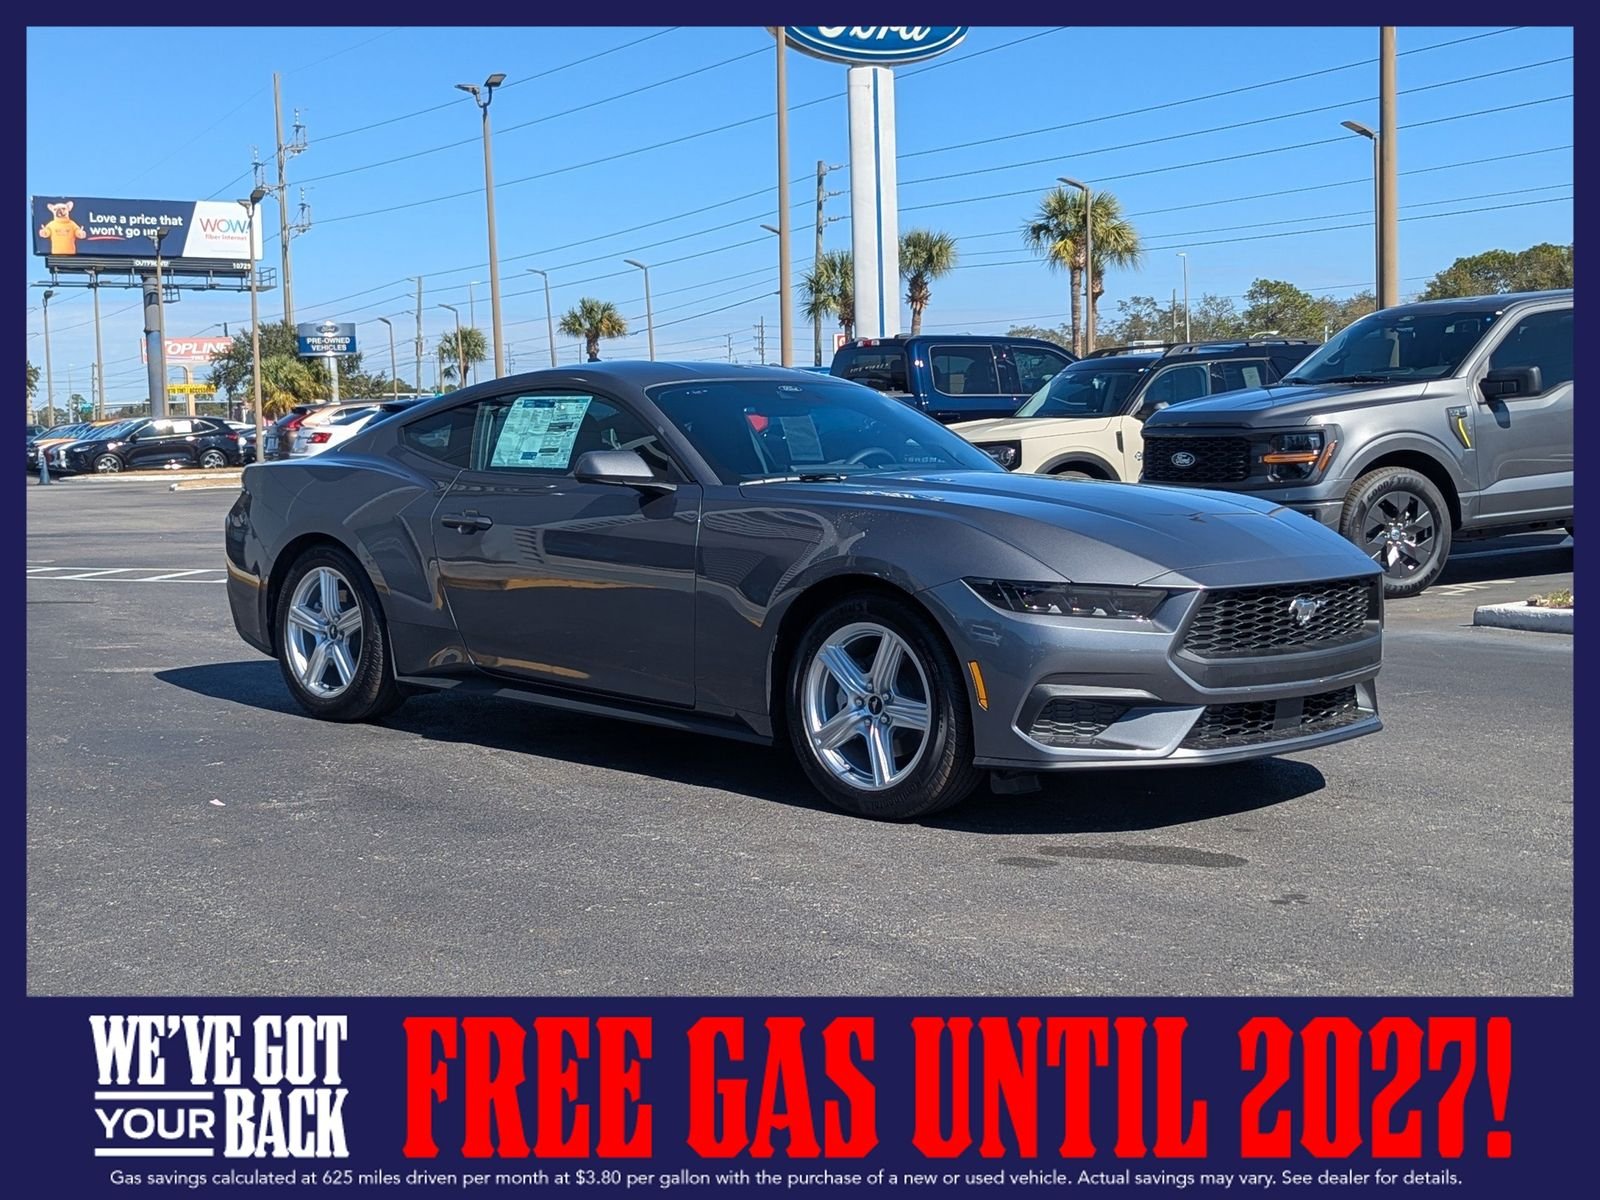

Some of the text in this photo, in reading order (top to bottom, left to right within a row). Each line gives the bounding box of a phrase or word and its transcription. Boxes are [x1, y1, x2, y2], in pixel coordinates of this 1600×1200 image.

[89, 211, 184, 227] Love a price that
[89, 224, 124, 237] won't
[125, 227, 141, 239] go
[306, 336, 351, 345] PRE-OWNED
[310, 344, 348, 352] VEHICLES
